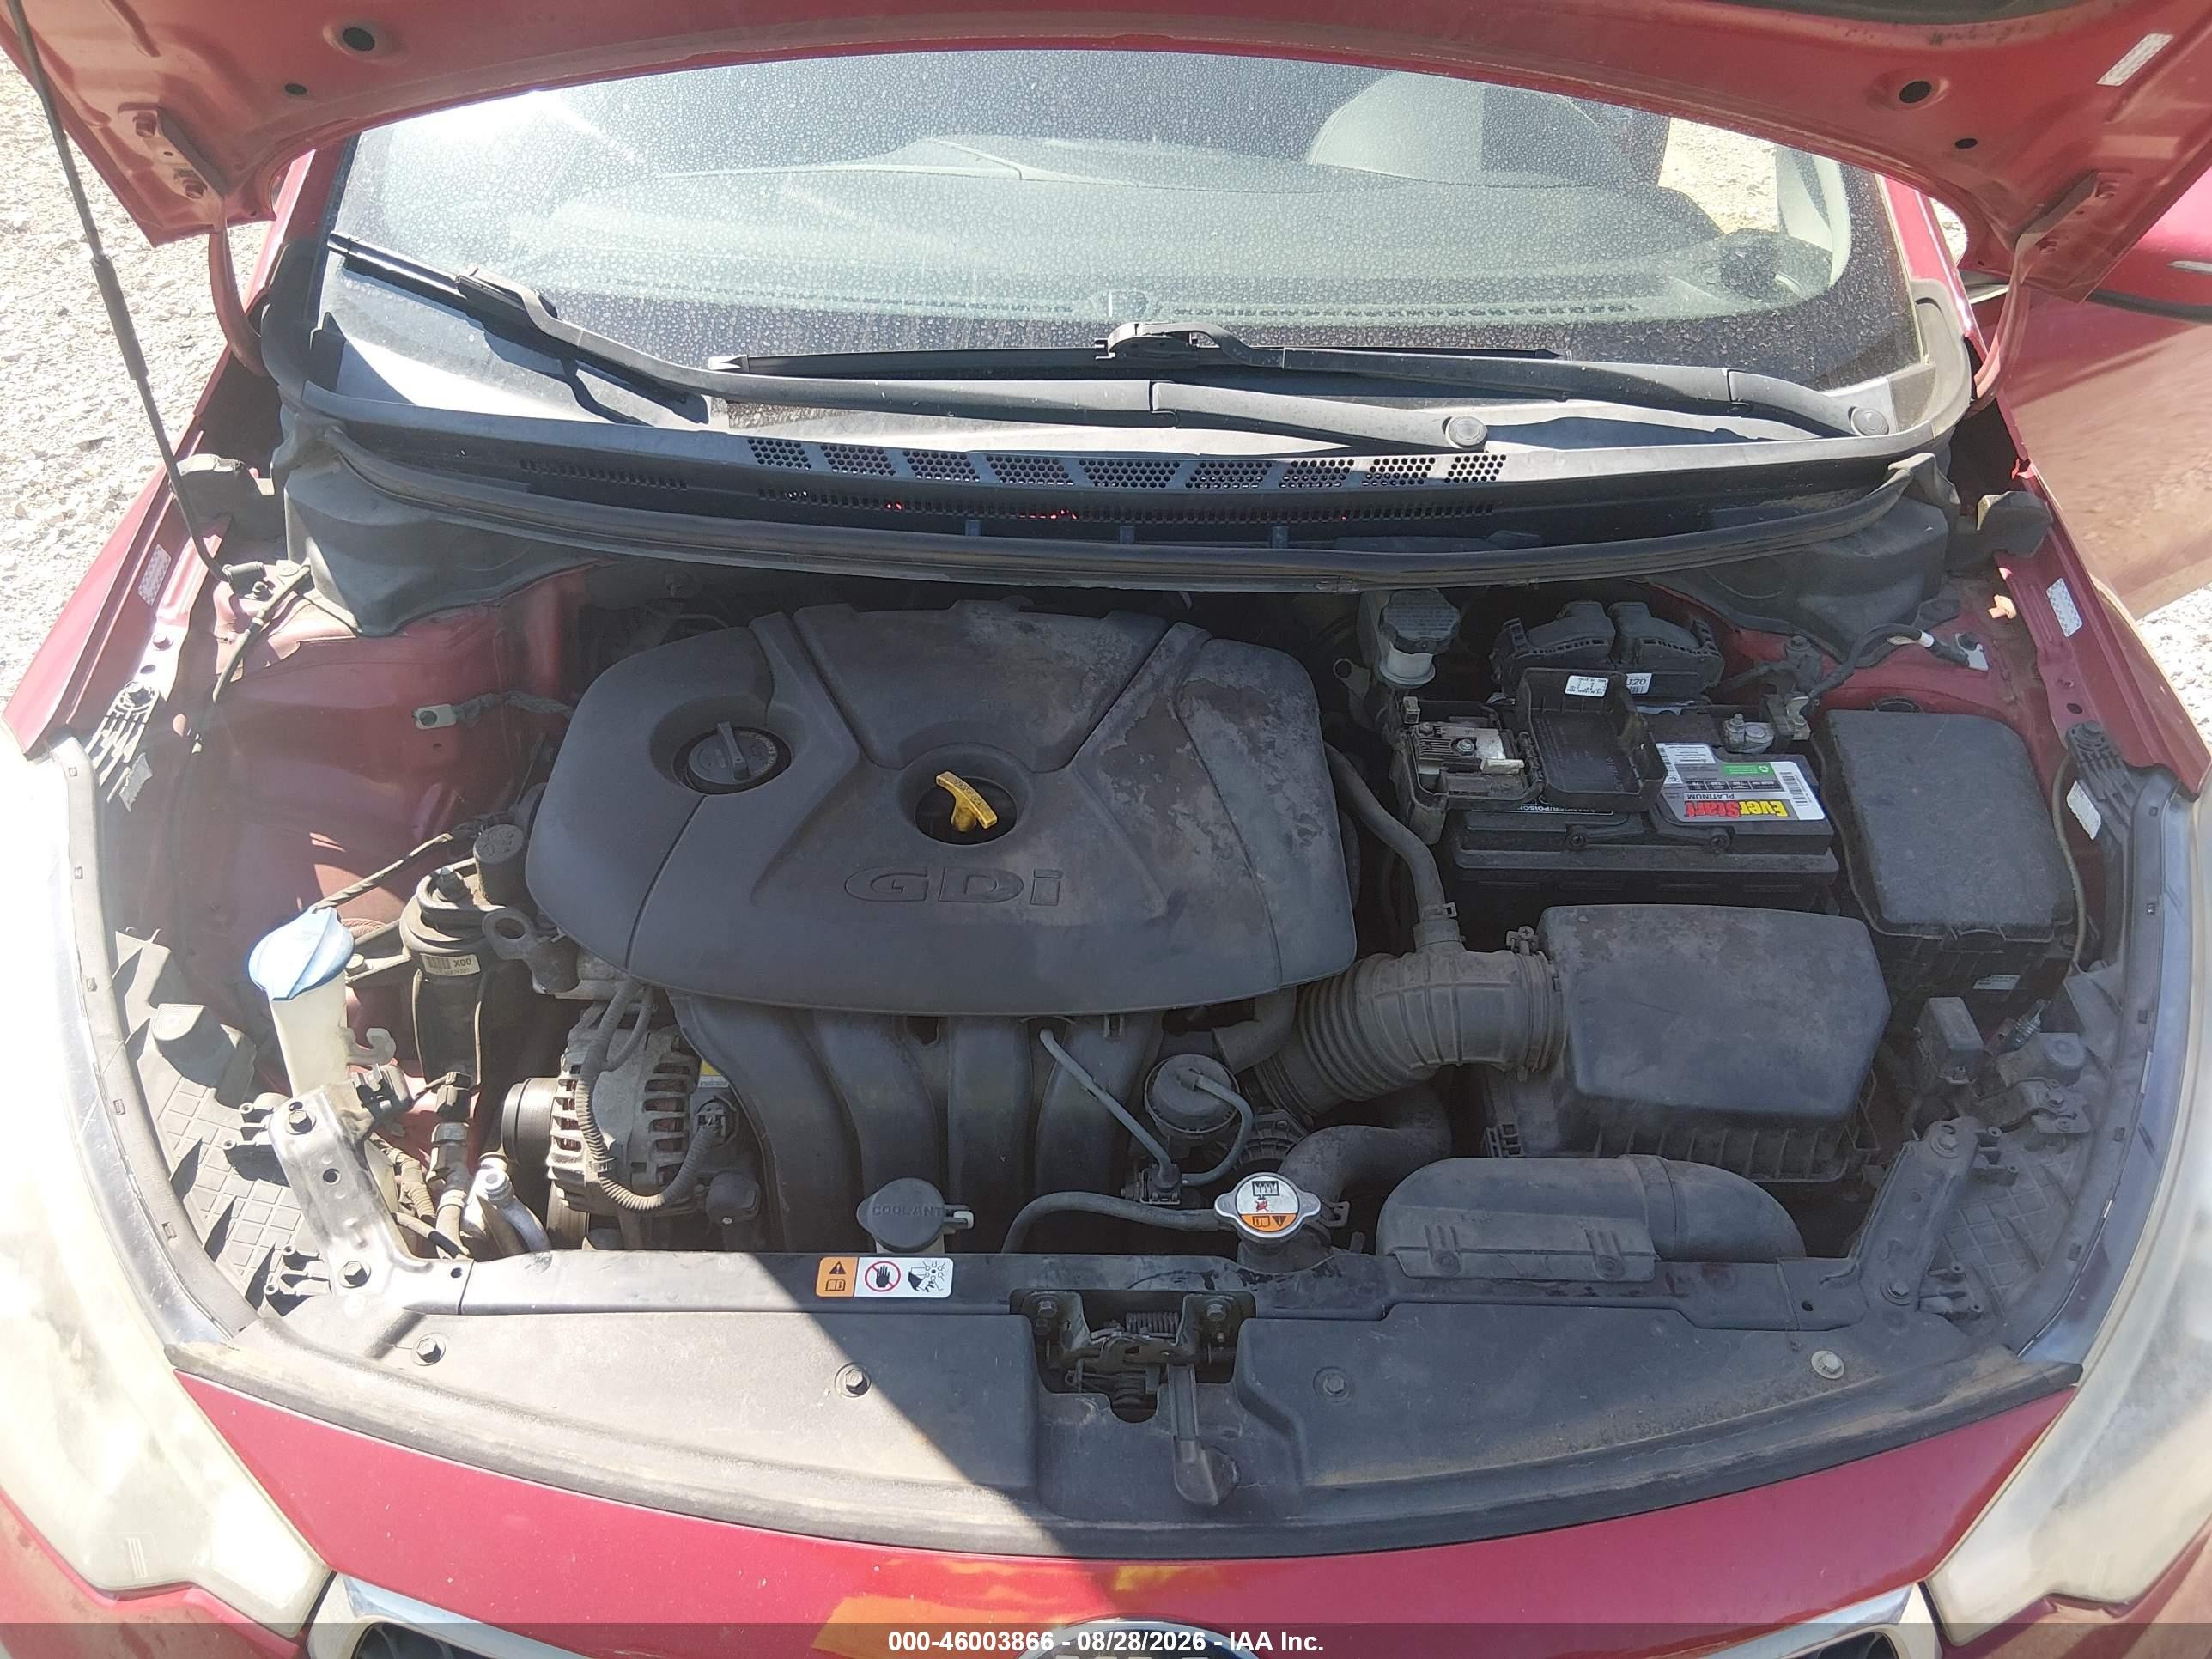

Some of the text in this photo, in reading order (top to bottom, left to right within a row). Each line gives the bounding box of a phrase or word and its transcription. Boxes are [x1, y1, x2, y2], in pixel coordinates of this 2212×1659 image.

[1685, 799, 1789, 818] EverStart
[844, 867, 1064, 906] GDi
[453, 957, 472, 968] X00
[872, 1205, 942, 1217] COOLANT
